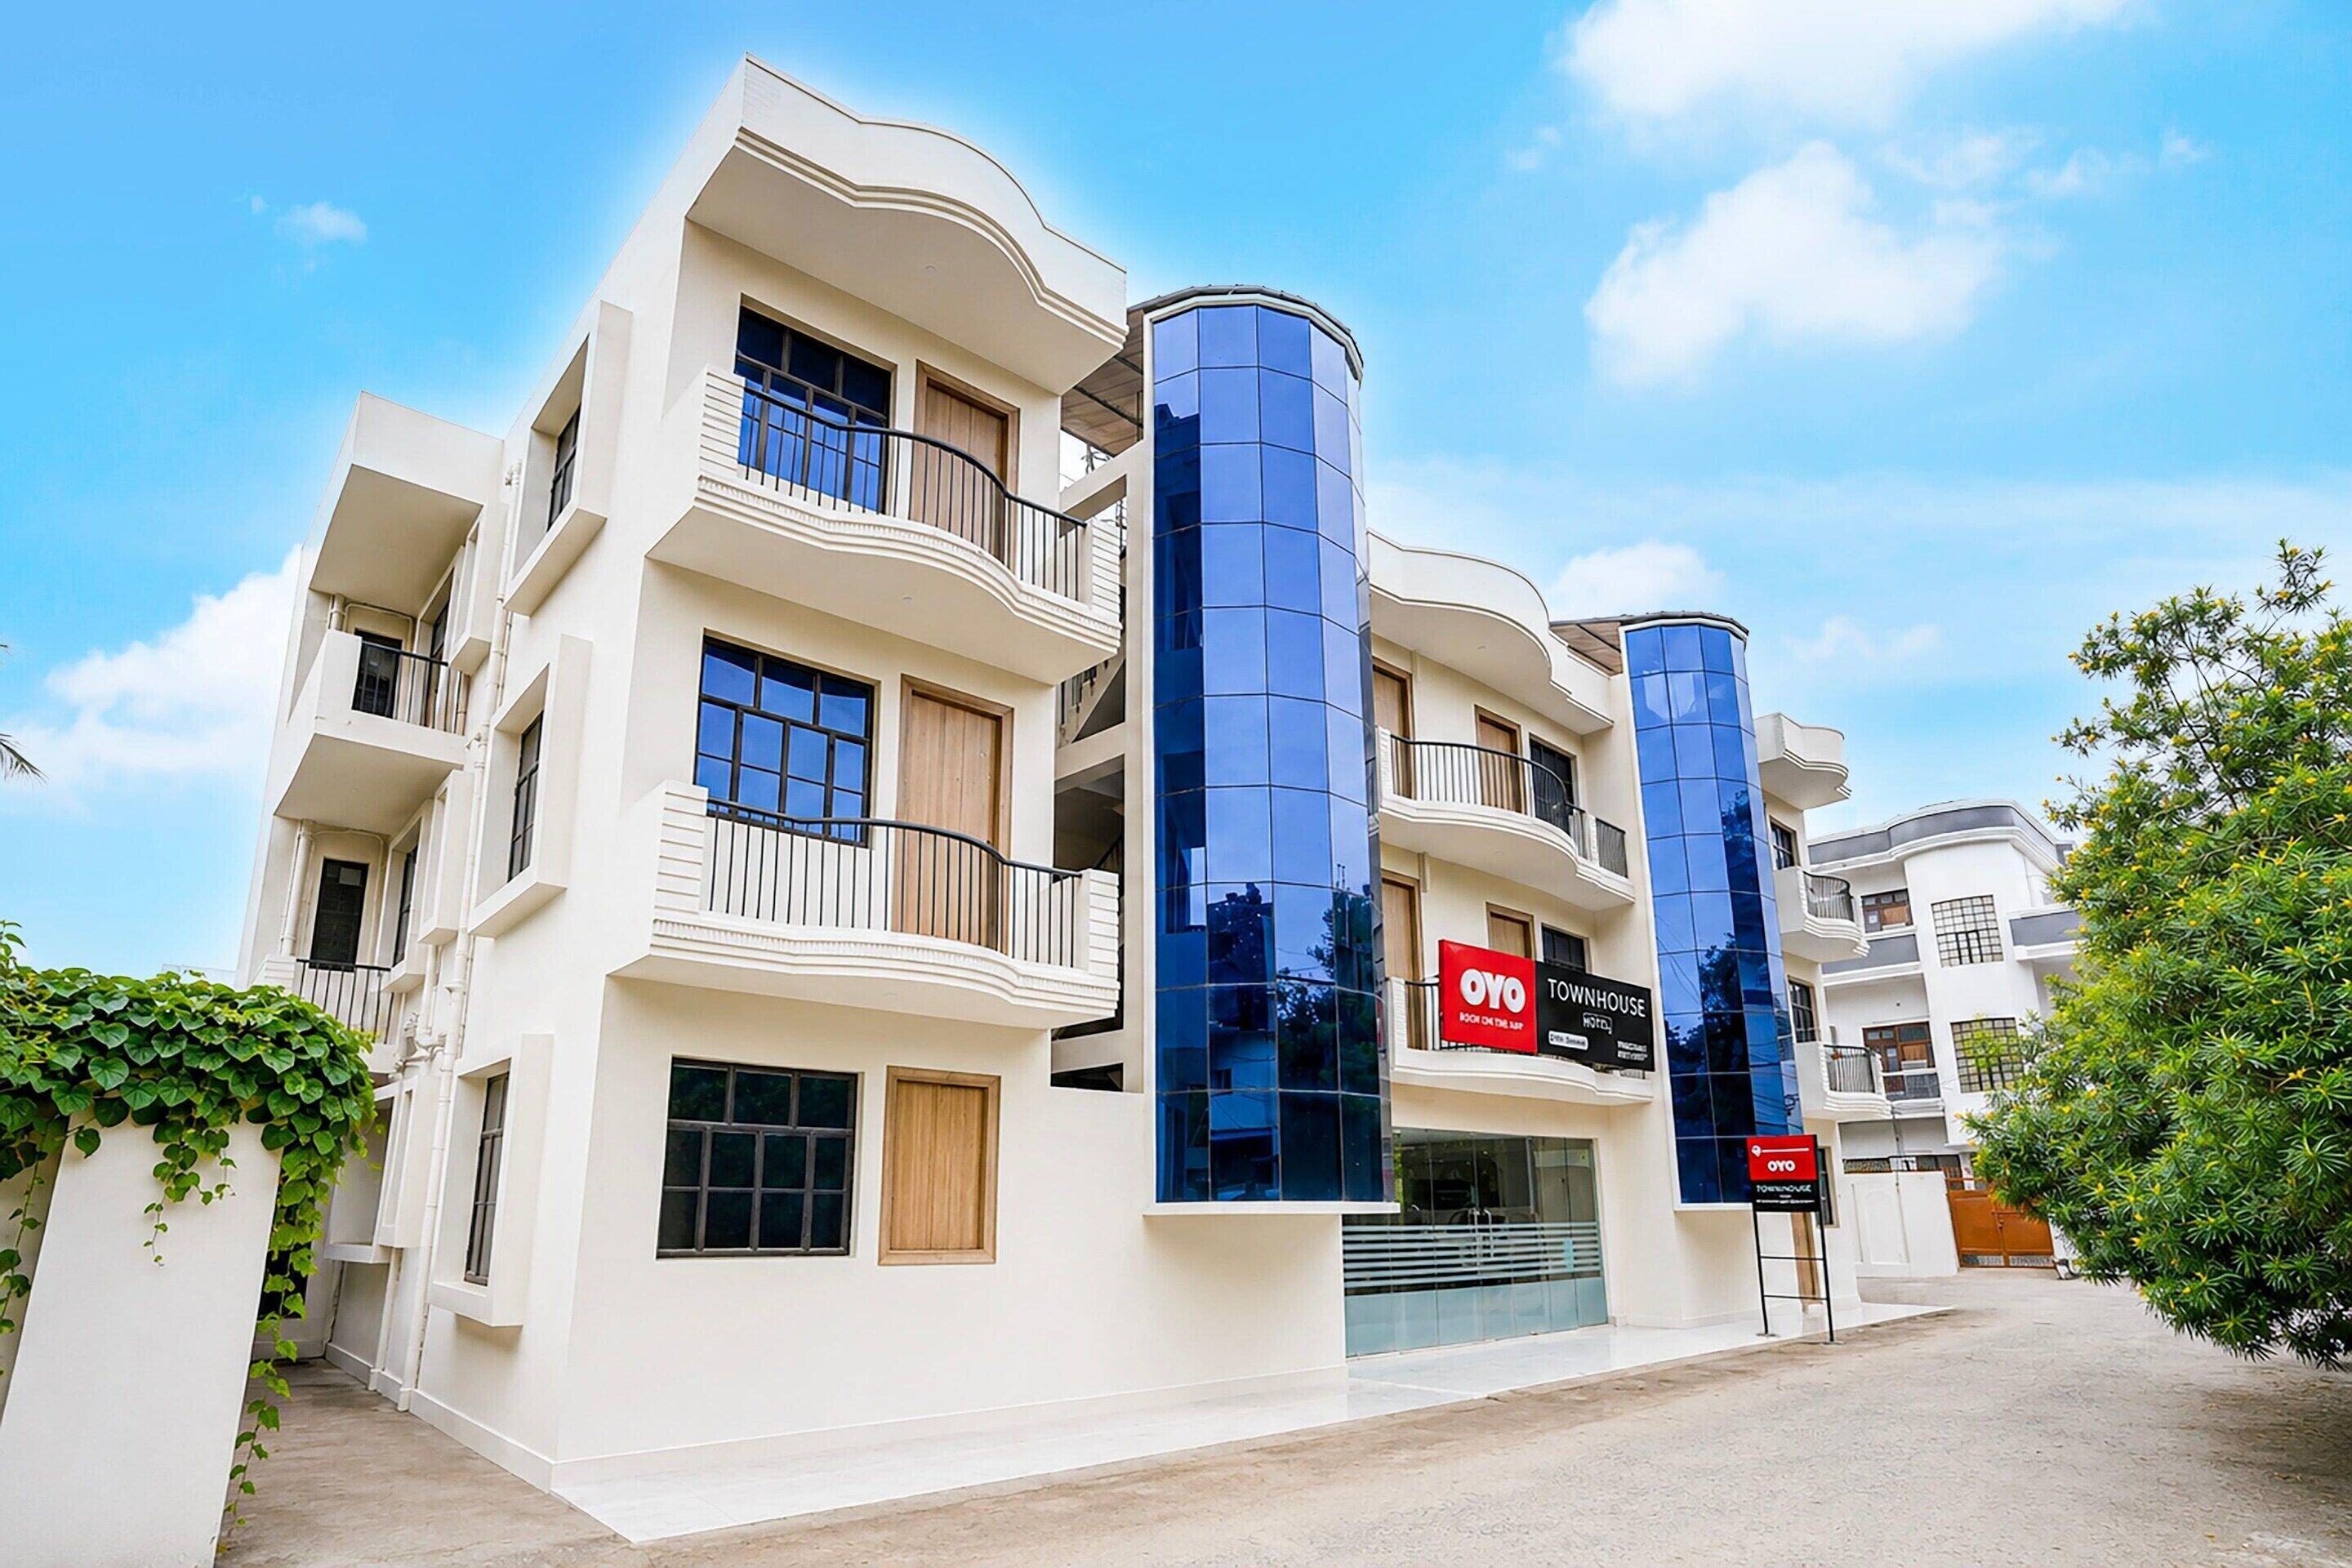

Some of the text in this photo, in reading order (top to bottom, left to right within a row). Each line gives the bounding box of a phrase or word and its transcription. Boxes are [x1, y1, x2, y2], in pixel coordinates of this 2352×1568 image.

[1460, 969, 1526, 1013] OYO
[1548, 978, 1646, 1018] TOWNHOUSE
[1767, 1160, 1796, 1172] OYO
